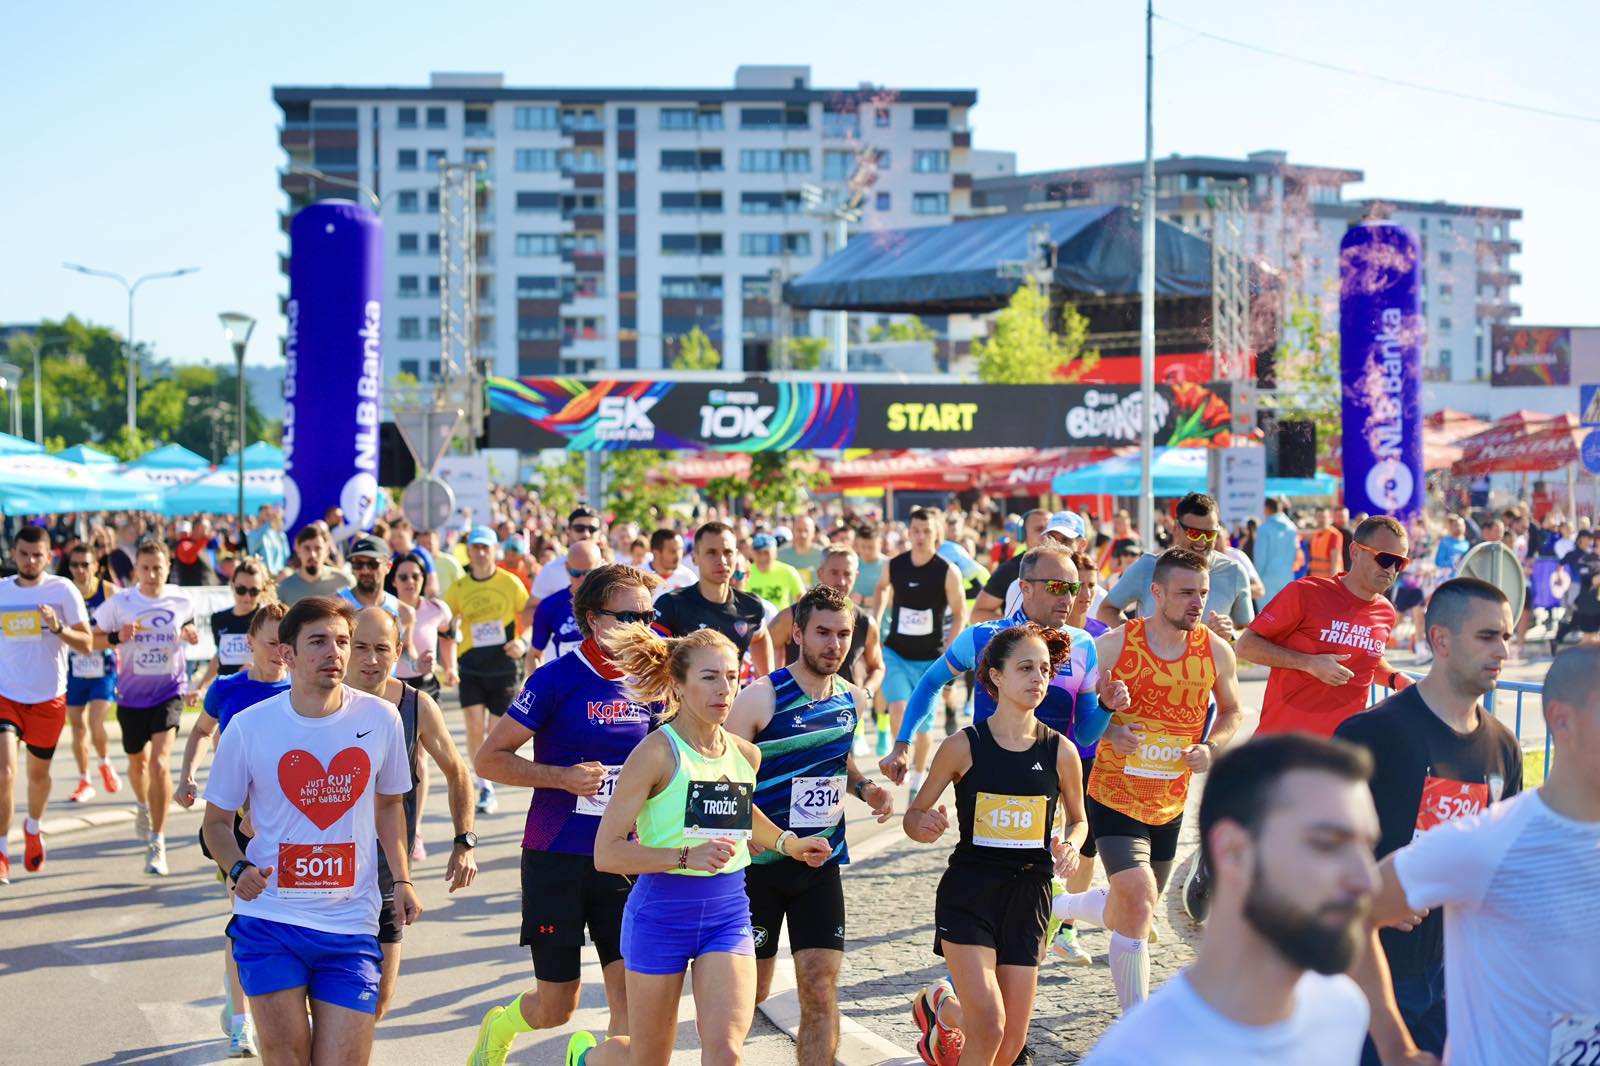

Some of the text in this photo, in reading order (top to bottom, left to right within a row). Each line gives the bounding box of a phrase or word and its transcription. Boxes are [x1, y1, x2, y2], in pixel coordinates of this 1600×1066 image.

[354, 300, 381, 469] NLB Banka
[597, 396, 659, 429] 5K
[700, 405, 774, 438] 10K
[887, 402, 978, 432] START
[1331, 620, 1371, 637] WE ARE
[141, 653, 168, 663] 2236
[1140, 744, 1182, 763] 1009
[306, 774, 351, 788] JUST RUN
[300, 794, 351, 806] THE BUBBLES
[301, 785, 352, 797] AND FOLLOW
[804, 789, 839, 807] 2314
[703, 796, 738, 815] TROŽIĆ
[989, 809, 1032, 829] 1518
[295, 857, 343, 877] 5011
